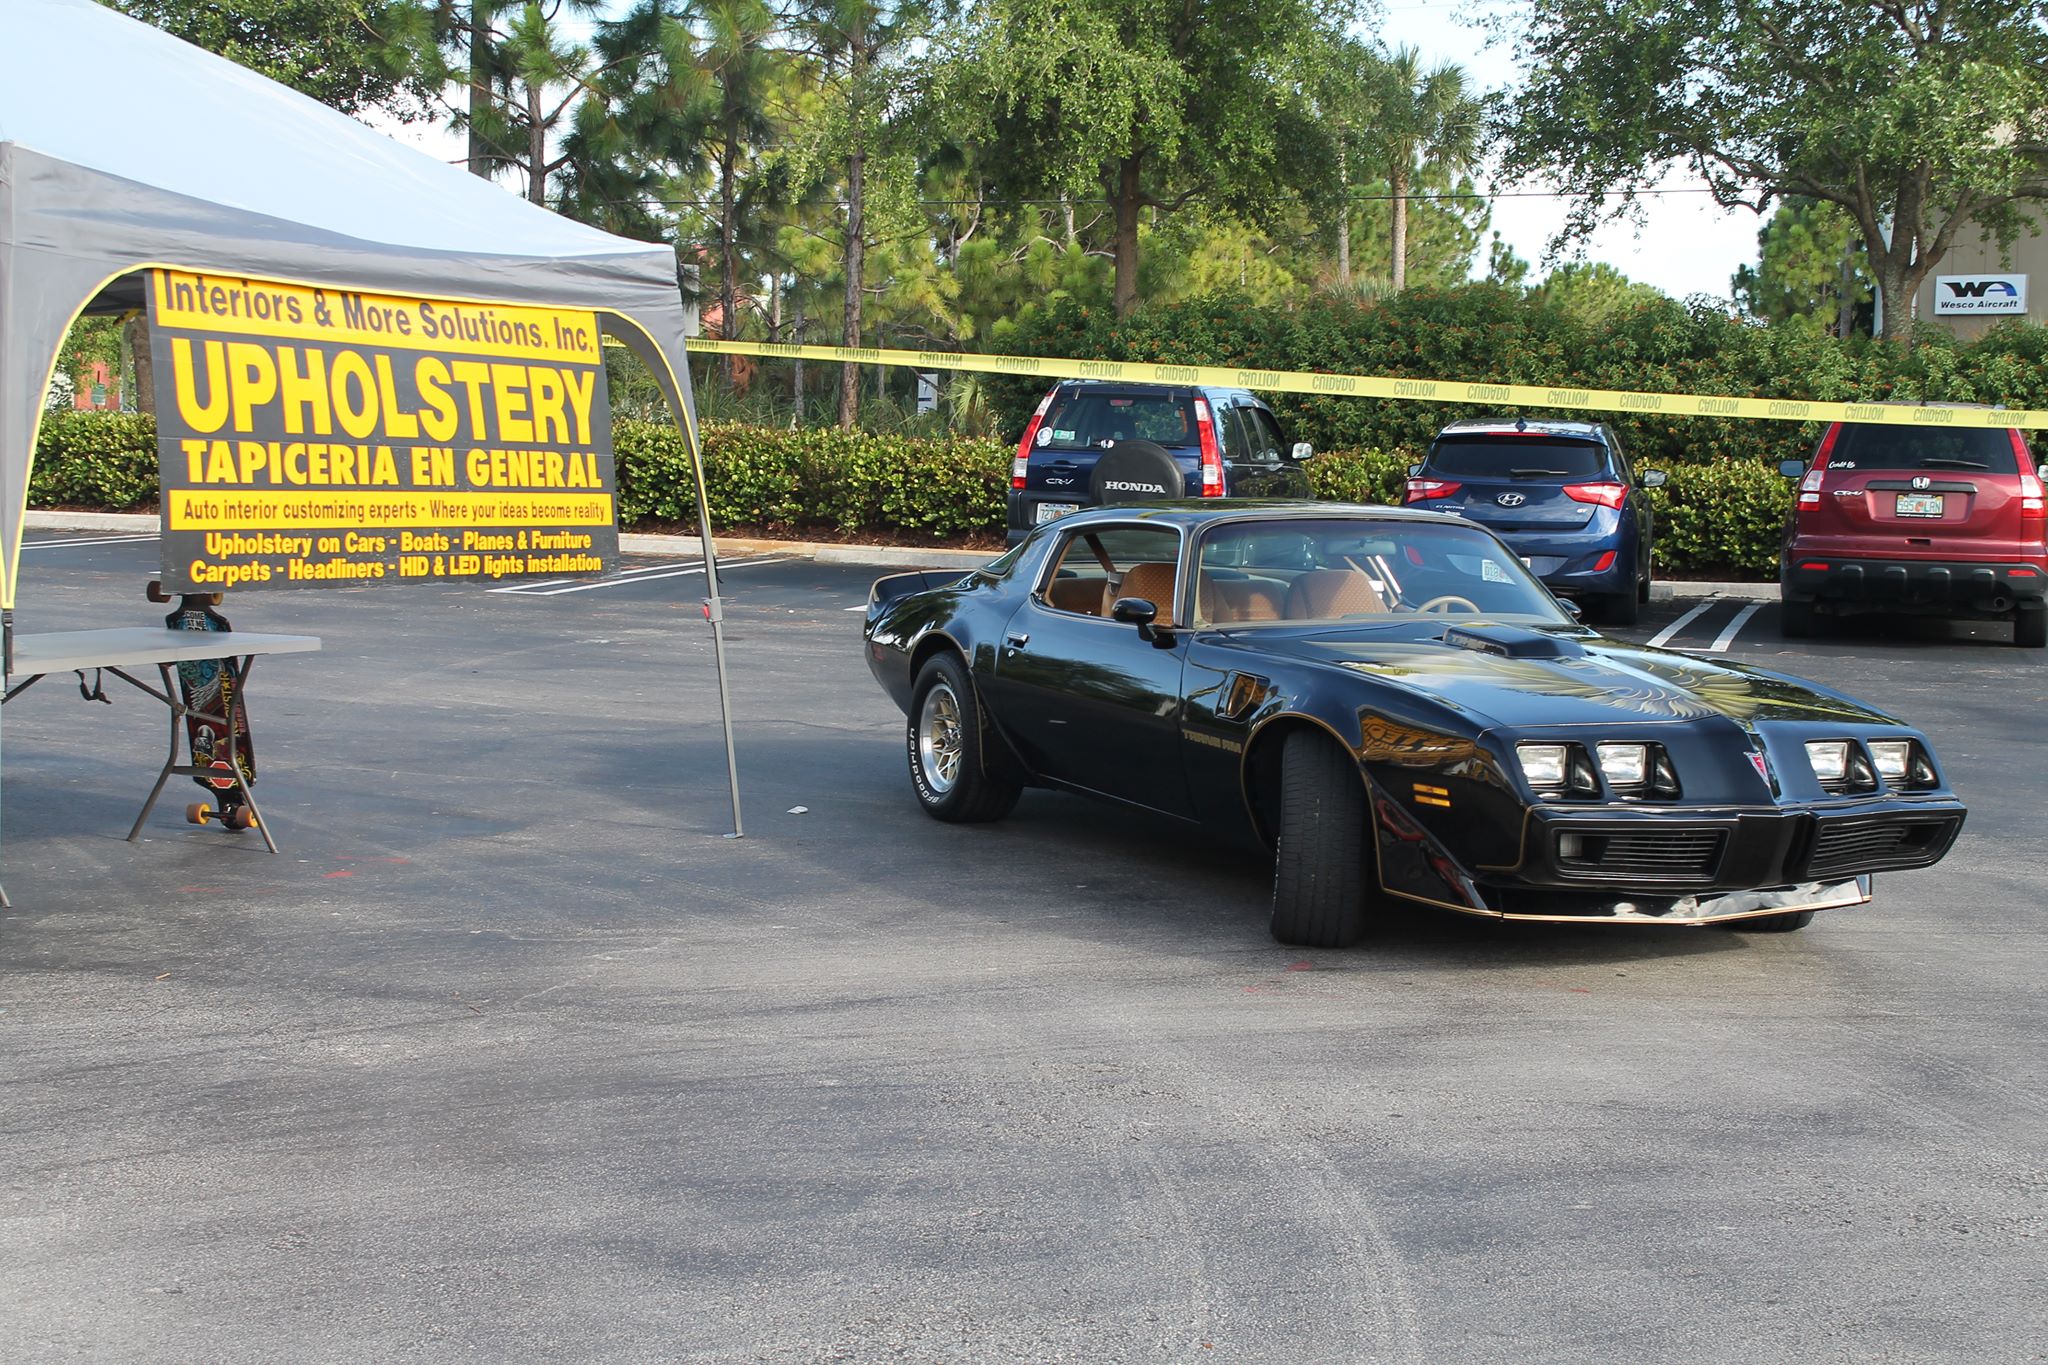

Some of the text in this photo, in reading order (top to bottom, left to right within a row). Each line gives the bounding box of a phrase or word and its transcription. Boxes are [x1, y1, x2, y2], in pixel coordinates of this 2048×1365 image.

[163, 270, 303, 325] Interiors
[314, 288, 335, 327] &
[340, 292, 411, 336] More
[554, 317, 593, 353] Inc.
[1941, 300, 2018, 309] Wesco Aircraft
[171, 337, 595, 445] UPHOLSTERY
[181, 439, 602, 488] TAPICERIA EN GENERAL
[1105, 481, 1166, 494] HONDA
[184, 499, 219, 520] Auto
[224, 499, 278, 520] interior
[283, 500, 365, 523] customizing
[370, 501, 417, 523] experts
[430, 500, 468, 519] Where
[472, 503, 496, 522] your
[499, 501, 528, 518] ideas
[531, 502, 571, 518] become
[574, 501, 605, 522] reality
[205, 532, 312, 560] Upholstery
[317, 536, 340, 553] on
[345, 531, 386, 553] Cars
[400, 531, 450, 552] Boats
[463, 531, 514, 551] Planes
[517, 530, 528, 550] &
[531, 530, 592, 550] Furniture
[190, 560, 271, 587] Carpets
[288, 558, 385, 580] Headliners
[399, 556, 429, 576] HID
[433, 555, 446, 576] &
[450, 555, 481, 575] LED
[484, 554, 524, 578] lights
[527, 553, 602, 573] installation
